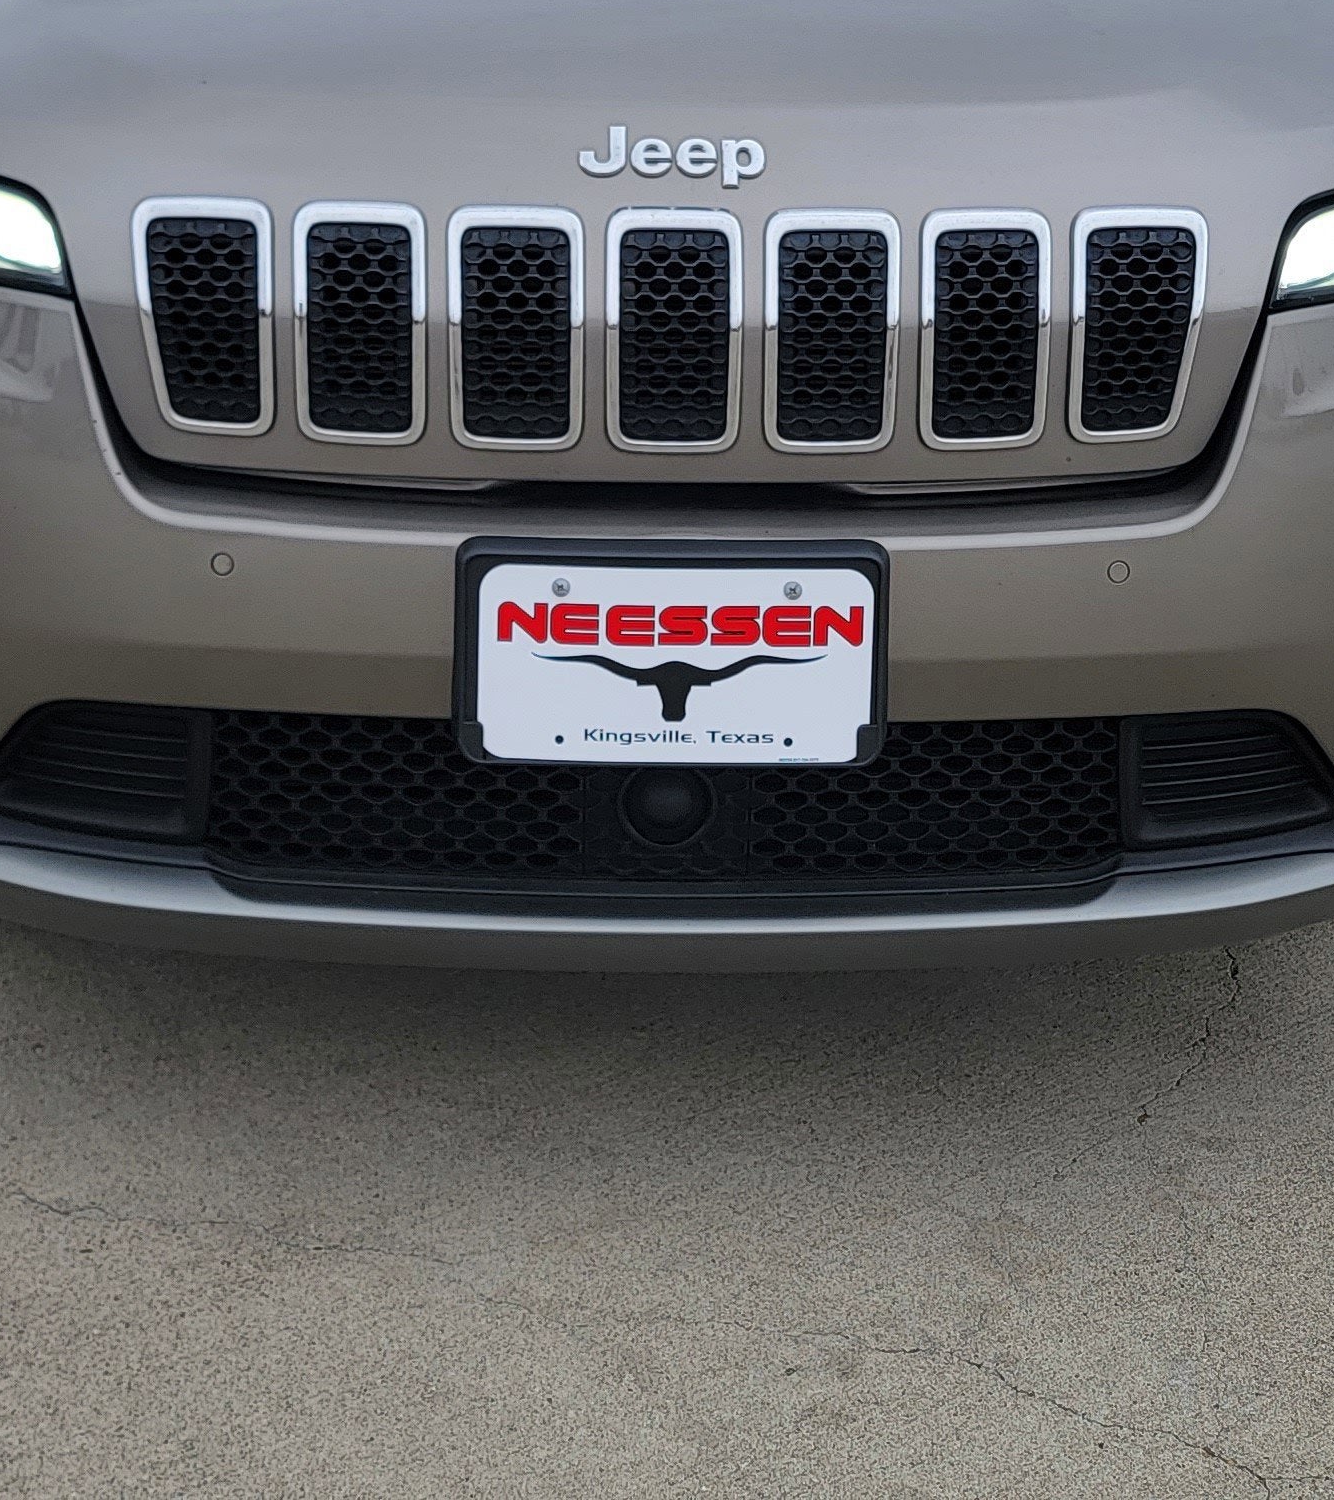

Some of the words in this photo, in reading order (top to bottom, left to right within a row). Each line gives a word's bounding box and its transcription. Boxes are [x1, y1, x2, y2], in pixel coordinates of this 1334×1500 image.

[578, 124, 765, 189] Jeep
[496, 600, 865, 648] NEESSEN
[583, 728, 697, 746] Kingsville,
[705, 730, 775, 744] Texas
